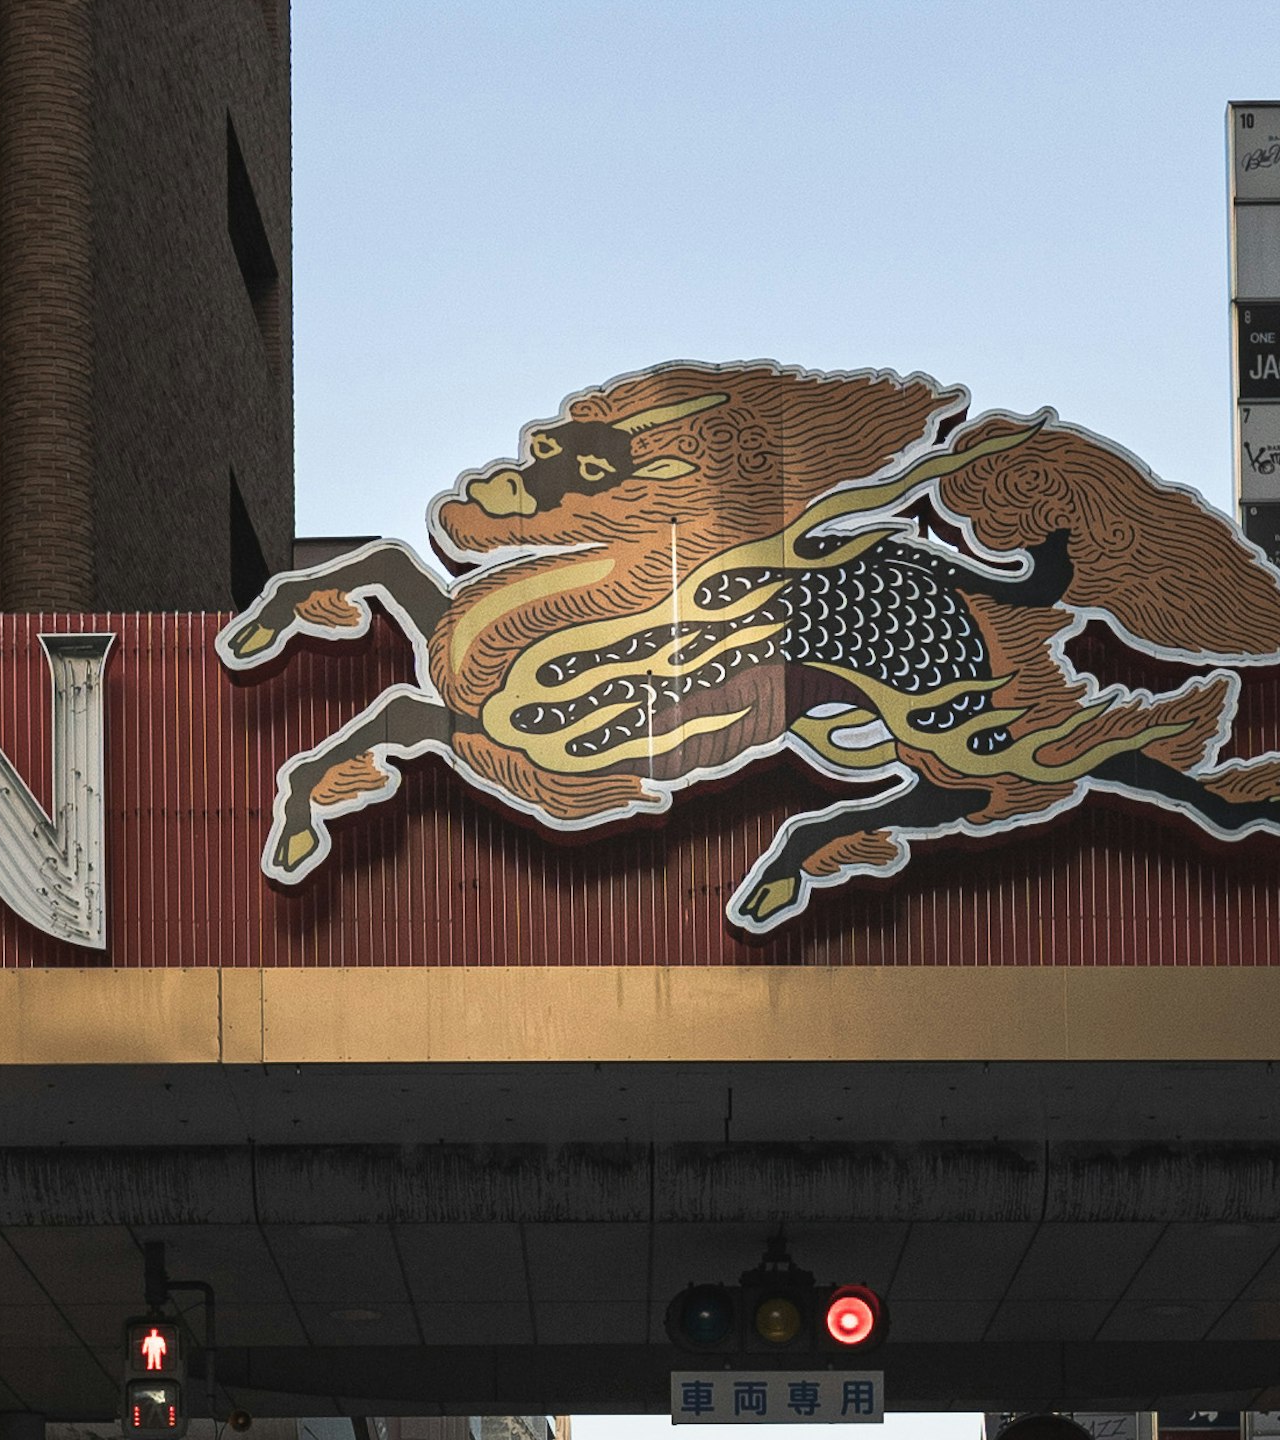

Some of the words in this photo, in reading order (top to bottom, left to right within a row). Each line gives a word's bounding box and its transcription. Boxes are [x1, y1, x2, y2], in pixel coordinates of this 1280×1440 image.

[1240, 113, 1255, 129] 10
[1244, 310, 1252, 324] 8
[1250, 332, 1276, 344] ONE
[1242, 408, 1251, 424] 7
[1250, 506, 1258, 516] 6
[680, 1380, 874, 1416] 車両専用
